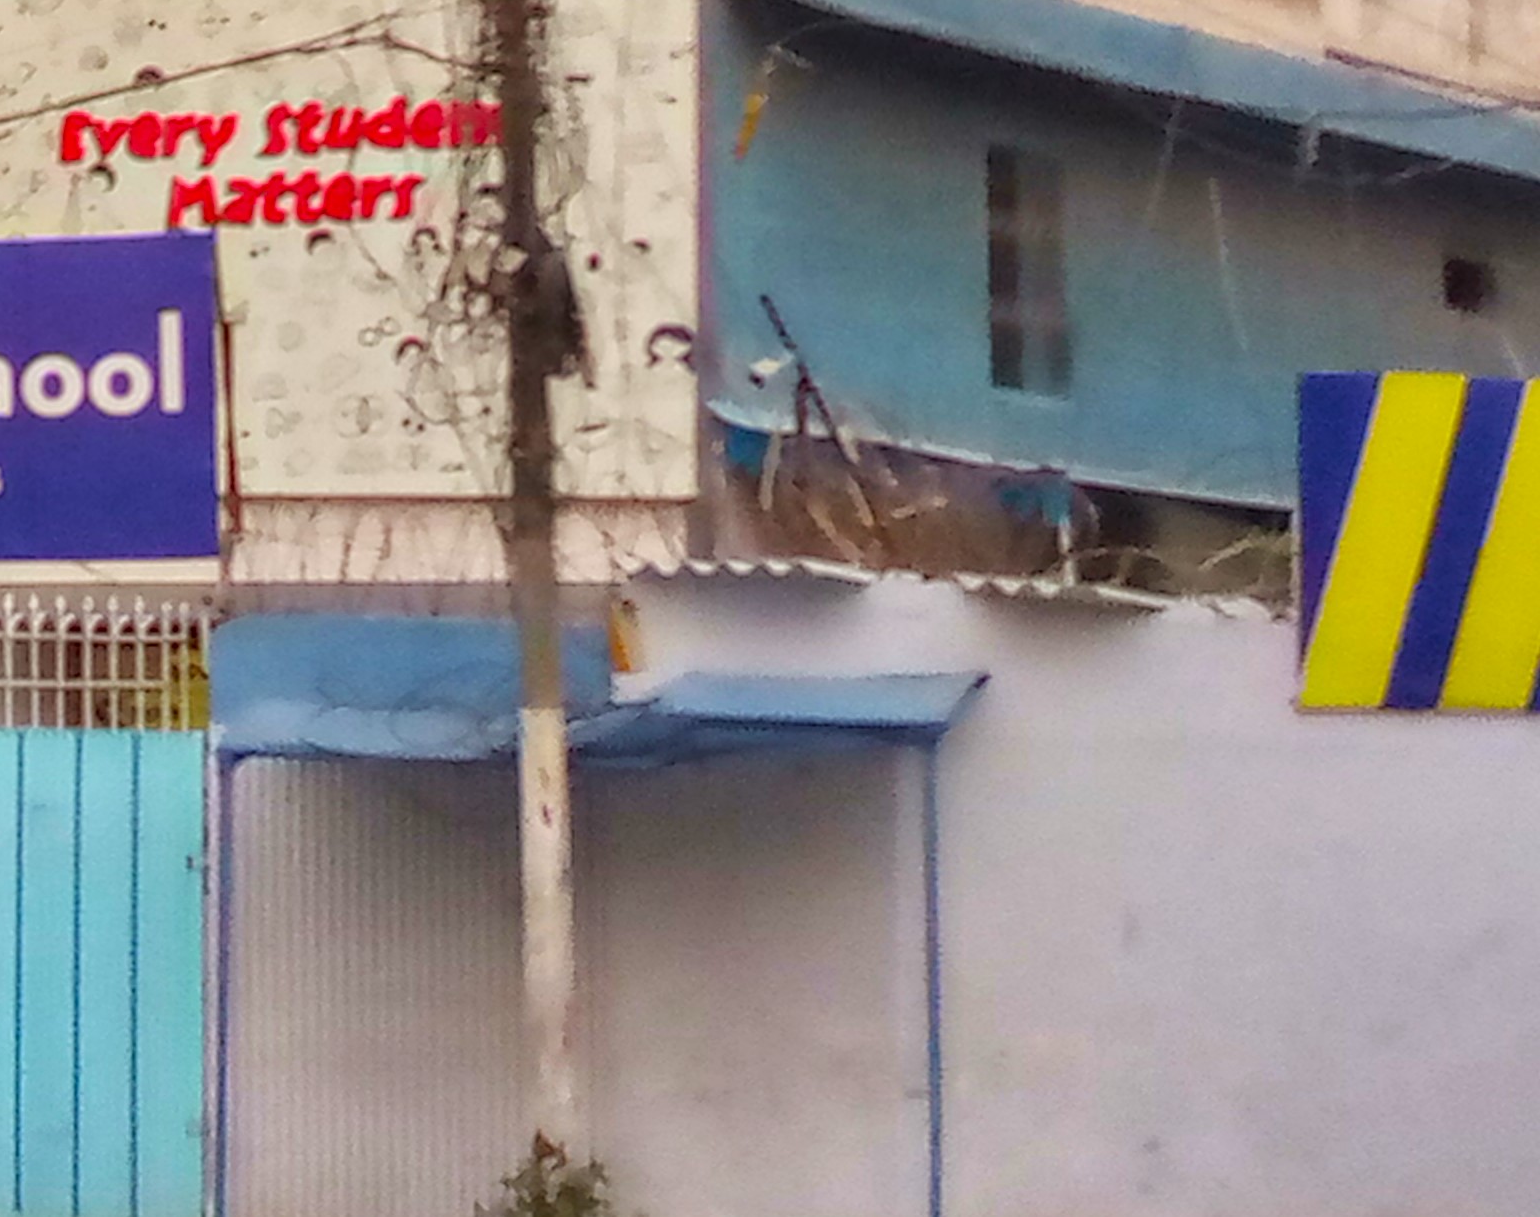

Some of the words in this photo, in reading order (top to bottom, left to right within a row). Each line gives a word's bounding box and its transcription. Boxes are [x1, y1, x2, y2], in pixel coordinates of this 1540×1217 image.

[60, 110, 239, 167] Every
[260, 94, 504, 155] Studen
[168, 169, 425, 229] Matters
